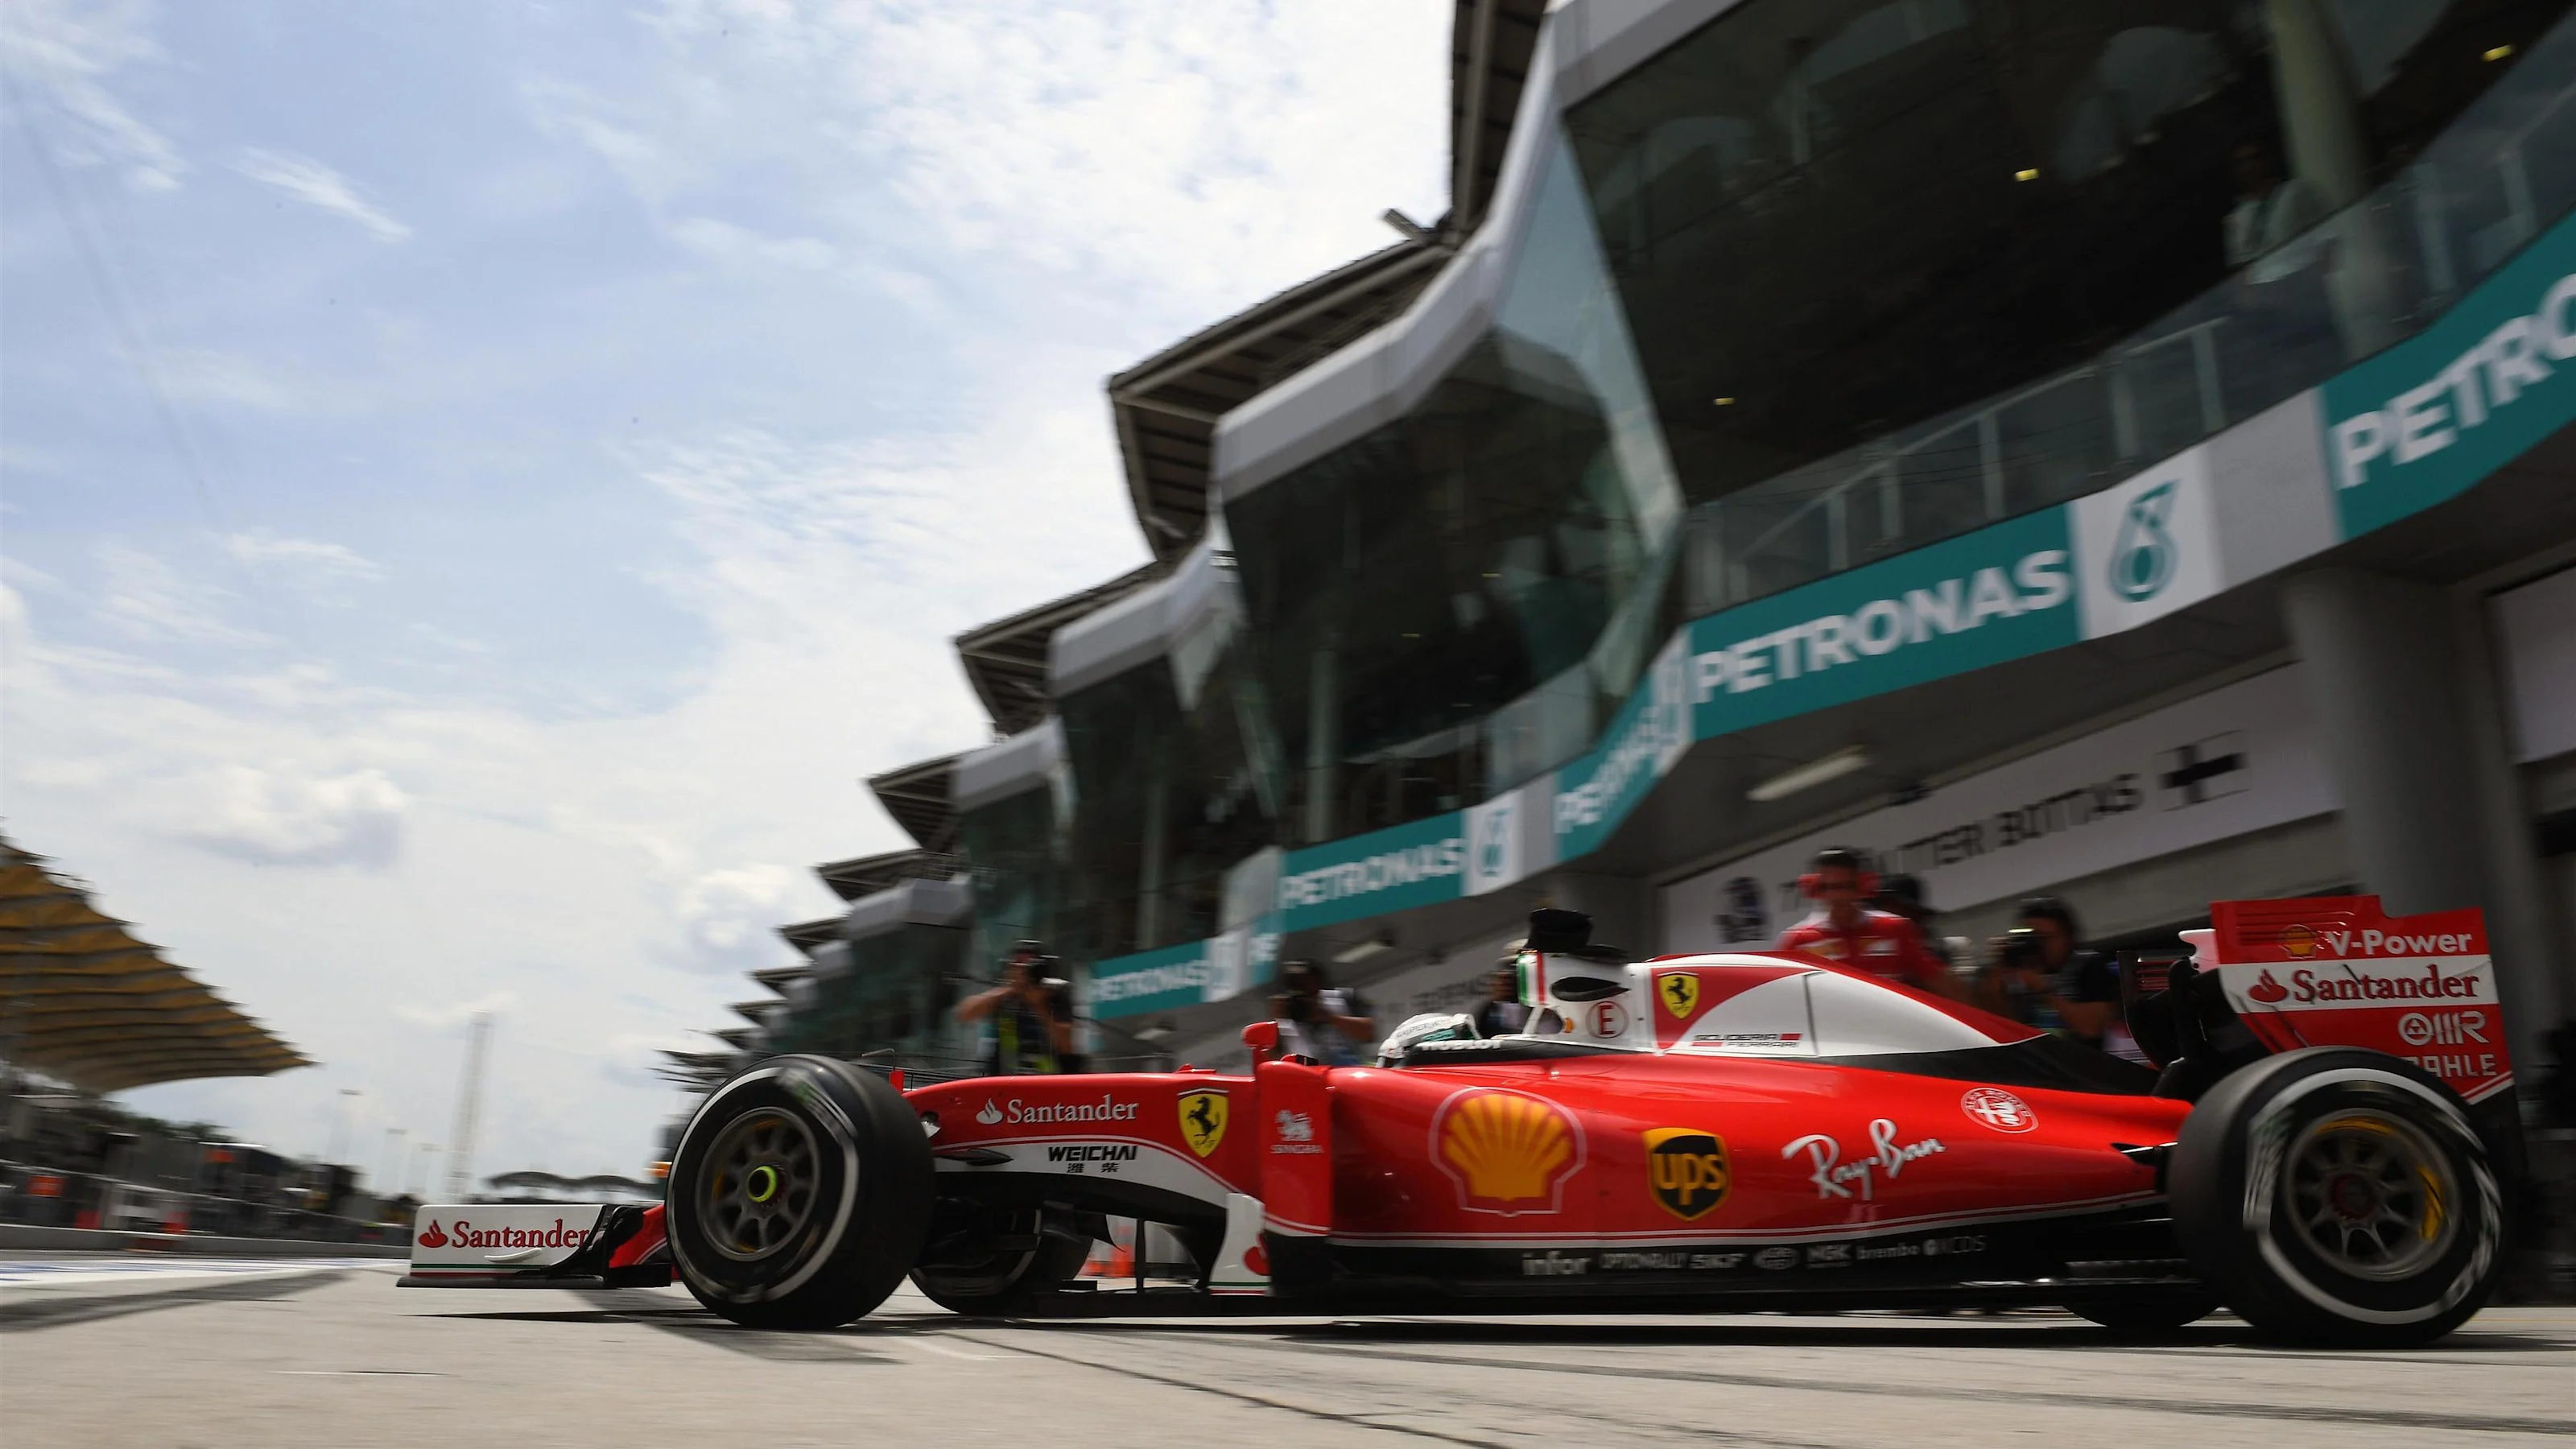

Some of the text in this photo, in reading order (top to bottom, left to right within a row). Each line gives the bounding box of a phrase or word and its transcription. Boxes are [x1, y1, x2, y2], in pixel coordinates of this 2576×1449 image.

[1690, 548, 2074, 704] PETRONAS
[1278, 836, 1468, 910] PETRONAS
[2325, 929, 2474, 956] V-Power
[2292, 963, 2479, 1003] Santander
[1598, 1005, 1614, 1034] E
[1692, 1033, 1778, 1042] SCUDERIA
[2399, 1054, 2498, 1078] AHLE
[1007, 1093, 1140, 1125] Santander
[1048, 1145, 1138, 1162] WEICHAI
[1781, 1117, 1946, 1201] Ray-Ban
[1652, 1153, 1728, 1206] ups
[452, 1217, 590, 1249] Santander
